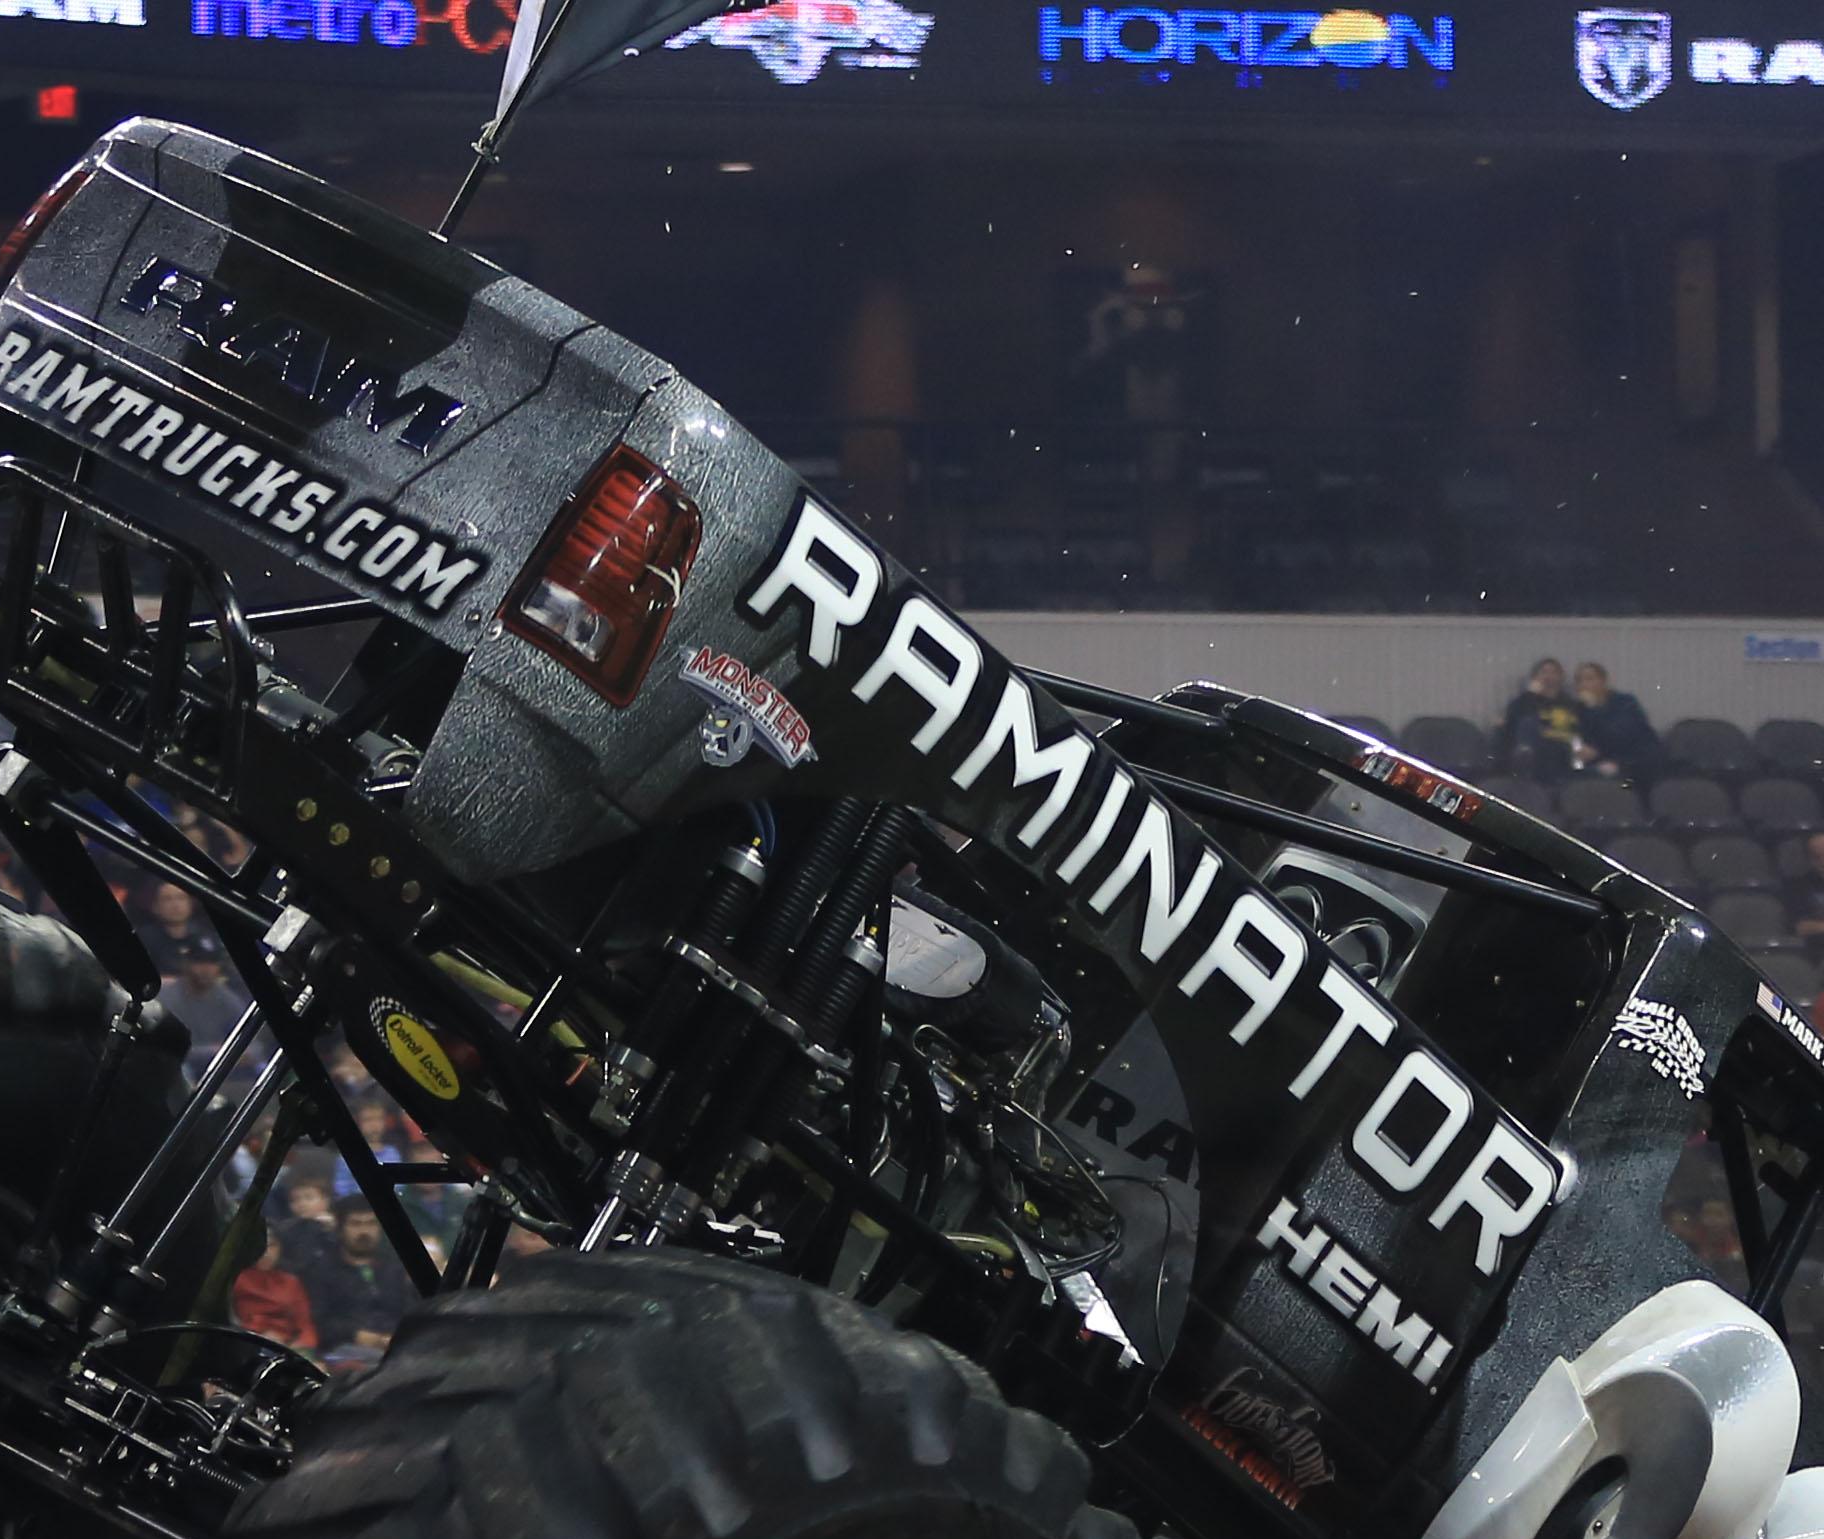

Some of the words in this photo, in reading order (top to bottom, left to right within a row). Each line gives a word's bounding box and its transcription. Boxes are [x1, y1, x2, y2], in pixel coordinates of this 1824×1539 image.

[1039, 6, 1455, 70] HORIZON
[119, 253, 468, 458] RAM
[684, 645, 811, 757] MONSTER
[744, 495, 1559, 1278] RAMINATOR
[1068, 1079, 1200, 1190] RA
[1255, 1195, 1456, 1387] HEMI
